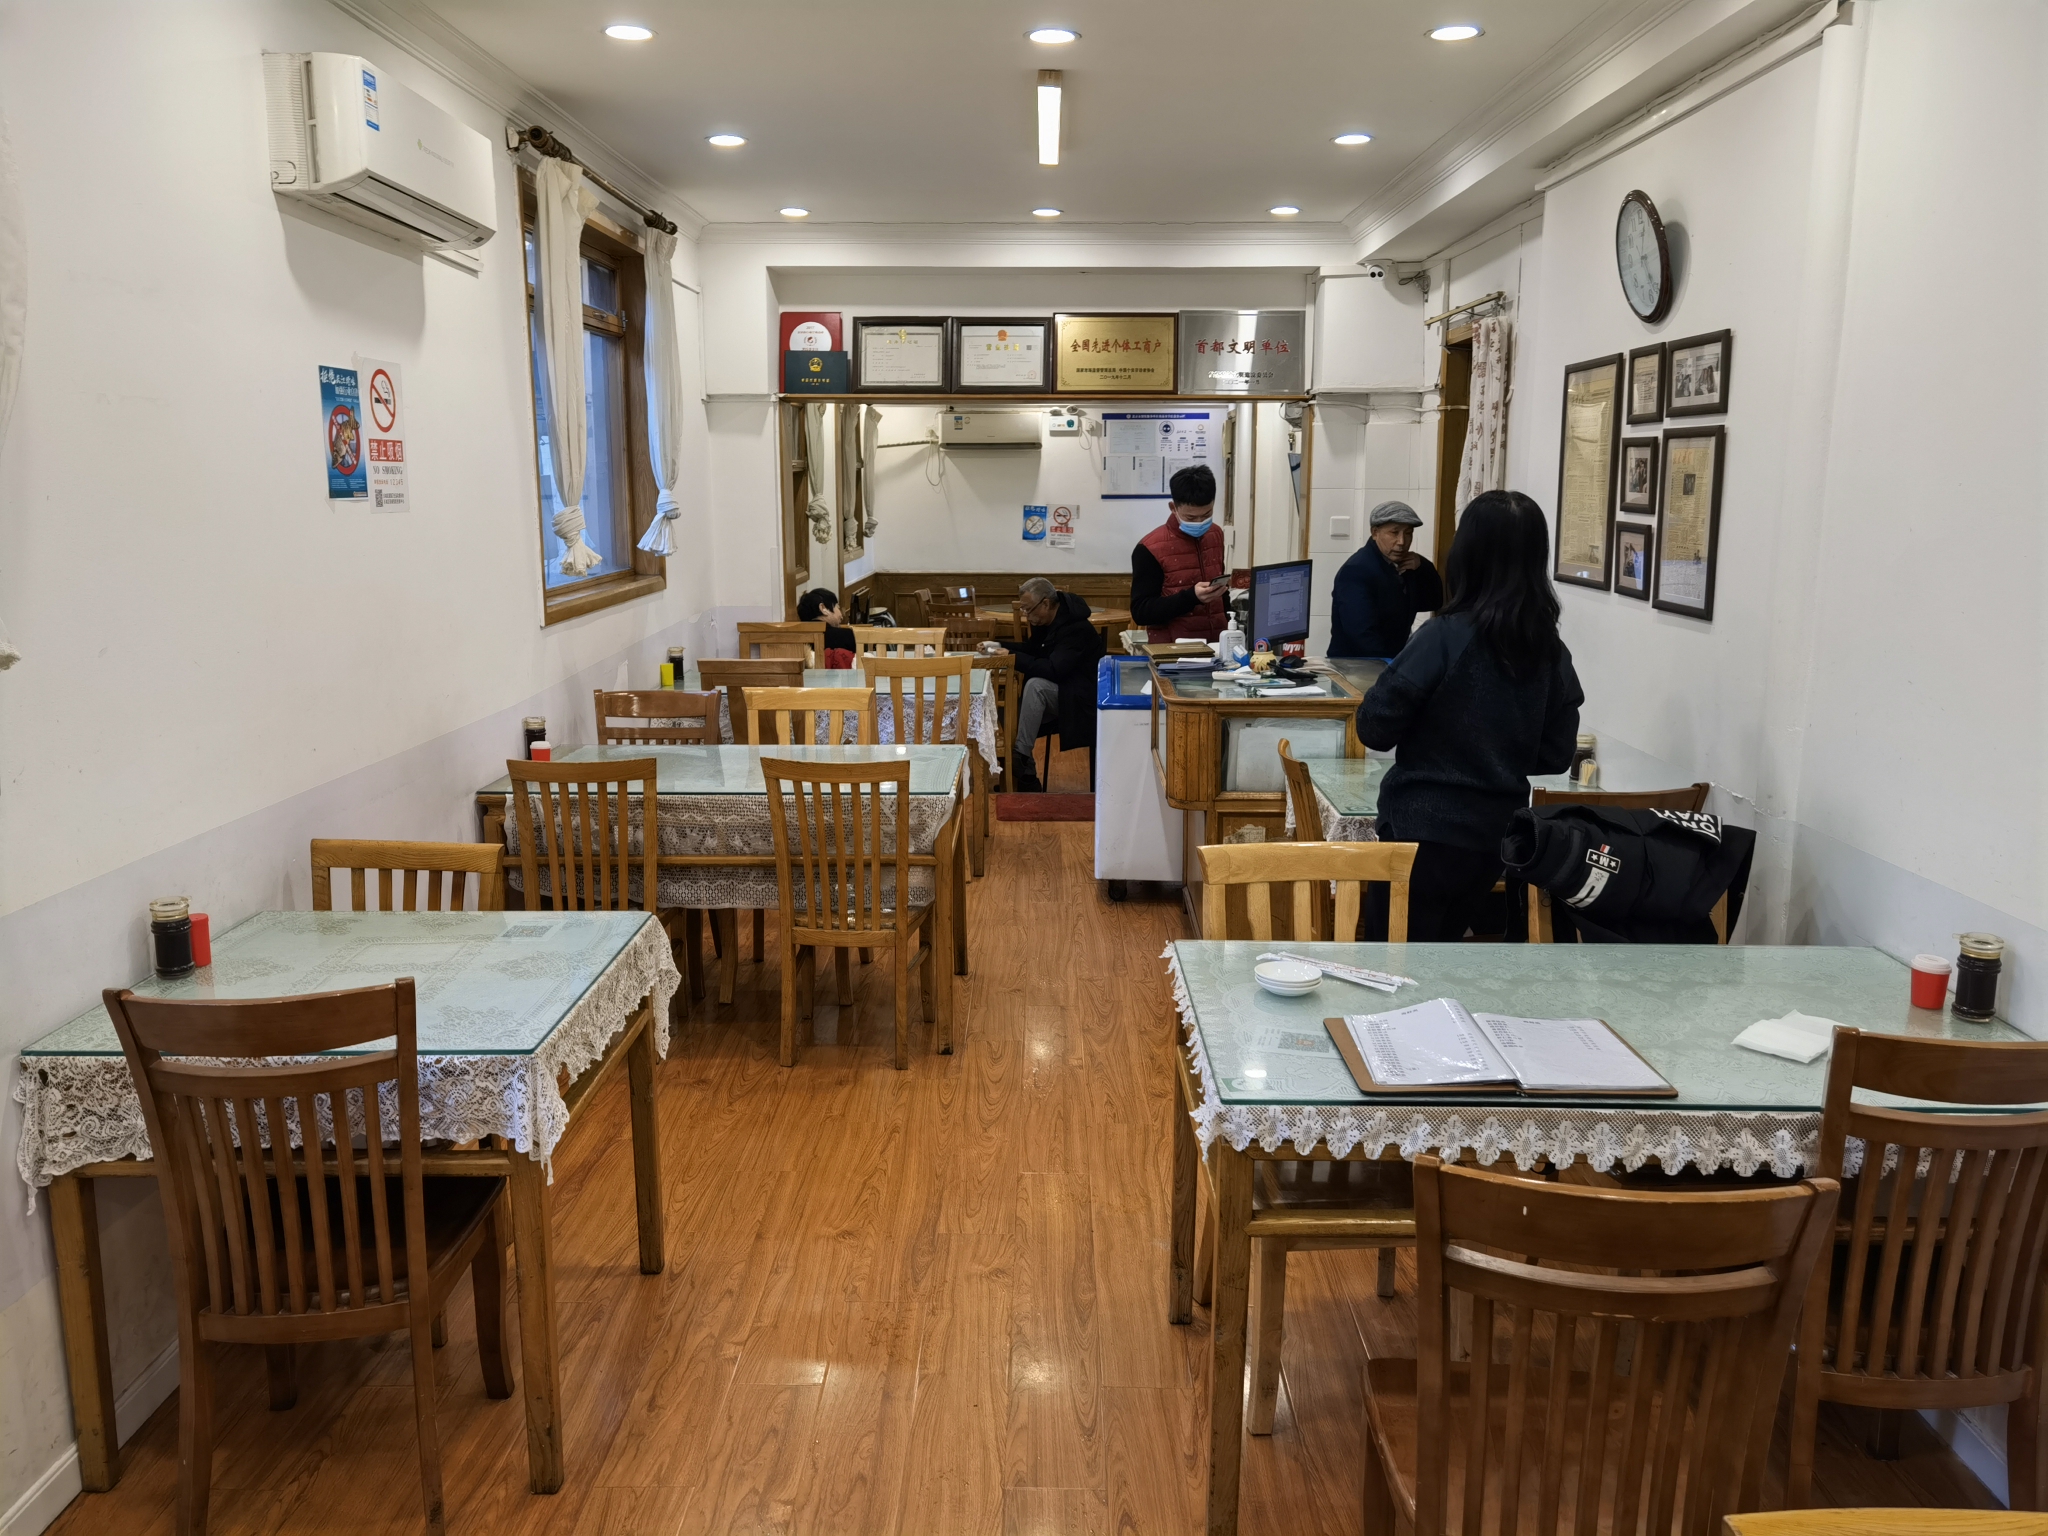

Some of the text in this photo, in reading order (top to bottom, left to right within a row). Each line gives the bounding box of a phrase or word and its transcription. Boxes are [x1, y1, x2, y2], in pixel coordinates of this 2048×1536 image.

[1070, 338, 1162, 354] 全国先进个体工商户
[1195, 338, 1290, 355] 首都文明单位
[370, 439, 403, 462] 禁止吸烟
[372, 465, 403, 475] NO SMOKING
[390, 478, 404, 486] 12345
[1664, 809, 1715, 823] WAY
[1599, 856, 1610, 868] M
